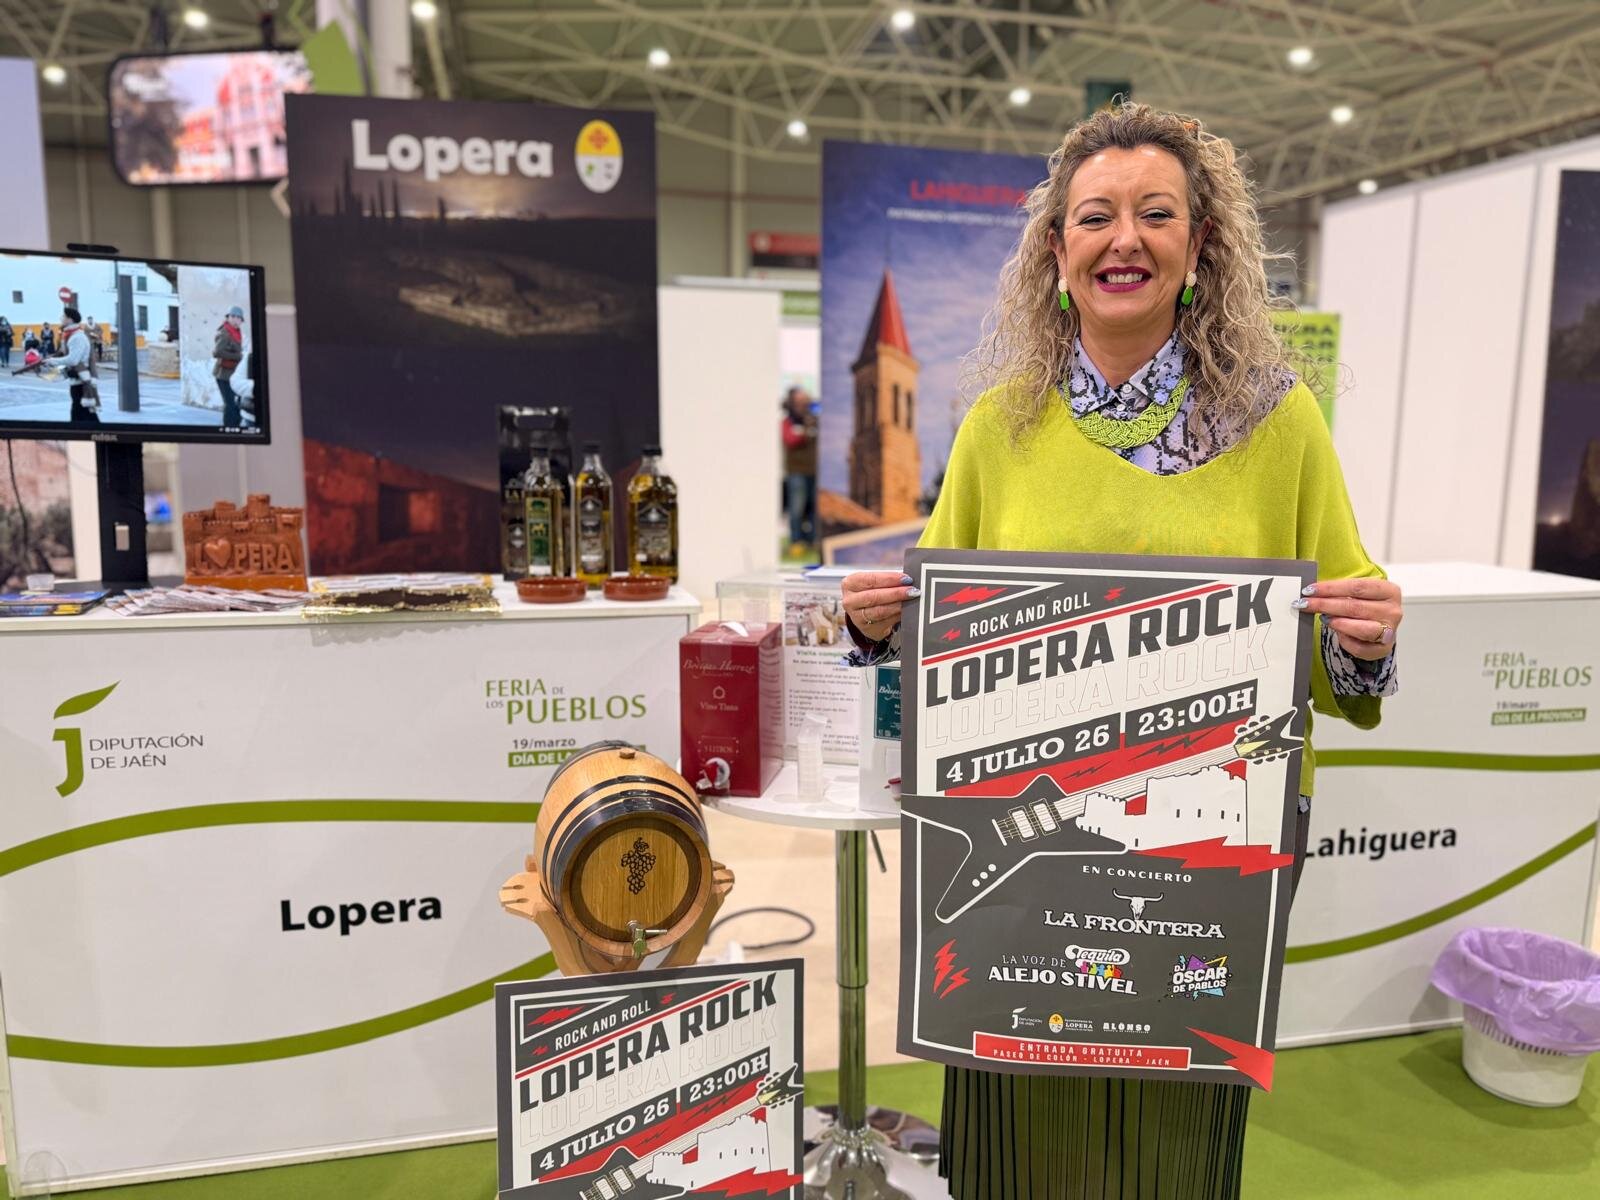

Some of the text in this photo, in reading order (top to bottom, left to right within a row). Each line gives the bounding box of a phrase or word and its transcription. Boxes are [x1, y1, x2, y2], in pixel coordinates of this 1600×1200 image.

[351, 118, 553, 182] Lopera
[970, 594, 1091, 638] ROCK AND ROLL
[926, 577, 1274, 708] LOPERA ROCK
[1483, 652, 1526, 668] FERIA
[486, 678, 565, 698] FERIA DE
[925, 663, 1114, 748] LOPERA
[1126, 621, 1273, 702] ROCK
[1494, 666, 1592, 690] PUEBLOS
[486, 694, 647, 725] LOS PUEBLOS
[89, 733, 204, 751] DIPUTACIÓN
[512, 738, 576, 750] 19/marzo
[946, 687, 1254, 783] 4 JULIO 26 23:00H
[91, 752, 167, 770] DE JAÉN
[512, 752, 535, 766] DÍA
[538, 752, 556, 764] DE
[1082, 865, 1192, 883] EN CONCIERTO
[280, 896, 442, 936] Lopera
[1044, 910, 1225, 938] LA FRONTERA
[1003, 954, 1067, 968] LA VOZ DE
[1173, 964, 1186, 972] DJ
[988, 966, 1138, 995] ALEJO STIVEL
[1172, 966, 1228, 985] OSCAR
[1172, 979, 1227, 993] DE PABLOS
[555, 1000, 651, 1051] ROCK AND ROLL
[519, 972, 777, 1113] LOPERA ROCK
[1020, 1042, 1142, 1057] ENTRADA GRATUITA
[993, 1049, 1024, 1059] PASEO
[1047, 1053, 1078, 1062] COLÓN
[1093, 1056, 1130, 1064] LOPERA
[519, 1006, 777, 1147] LOPERA ROCK
[540, 1052, 769, 1171] 4 JULIO 26 23:00H
